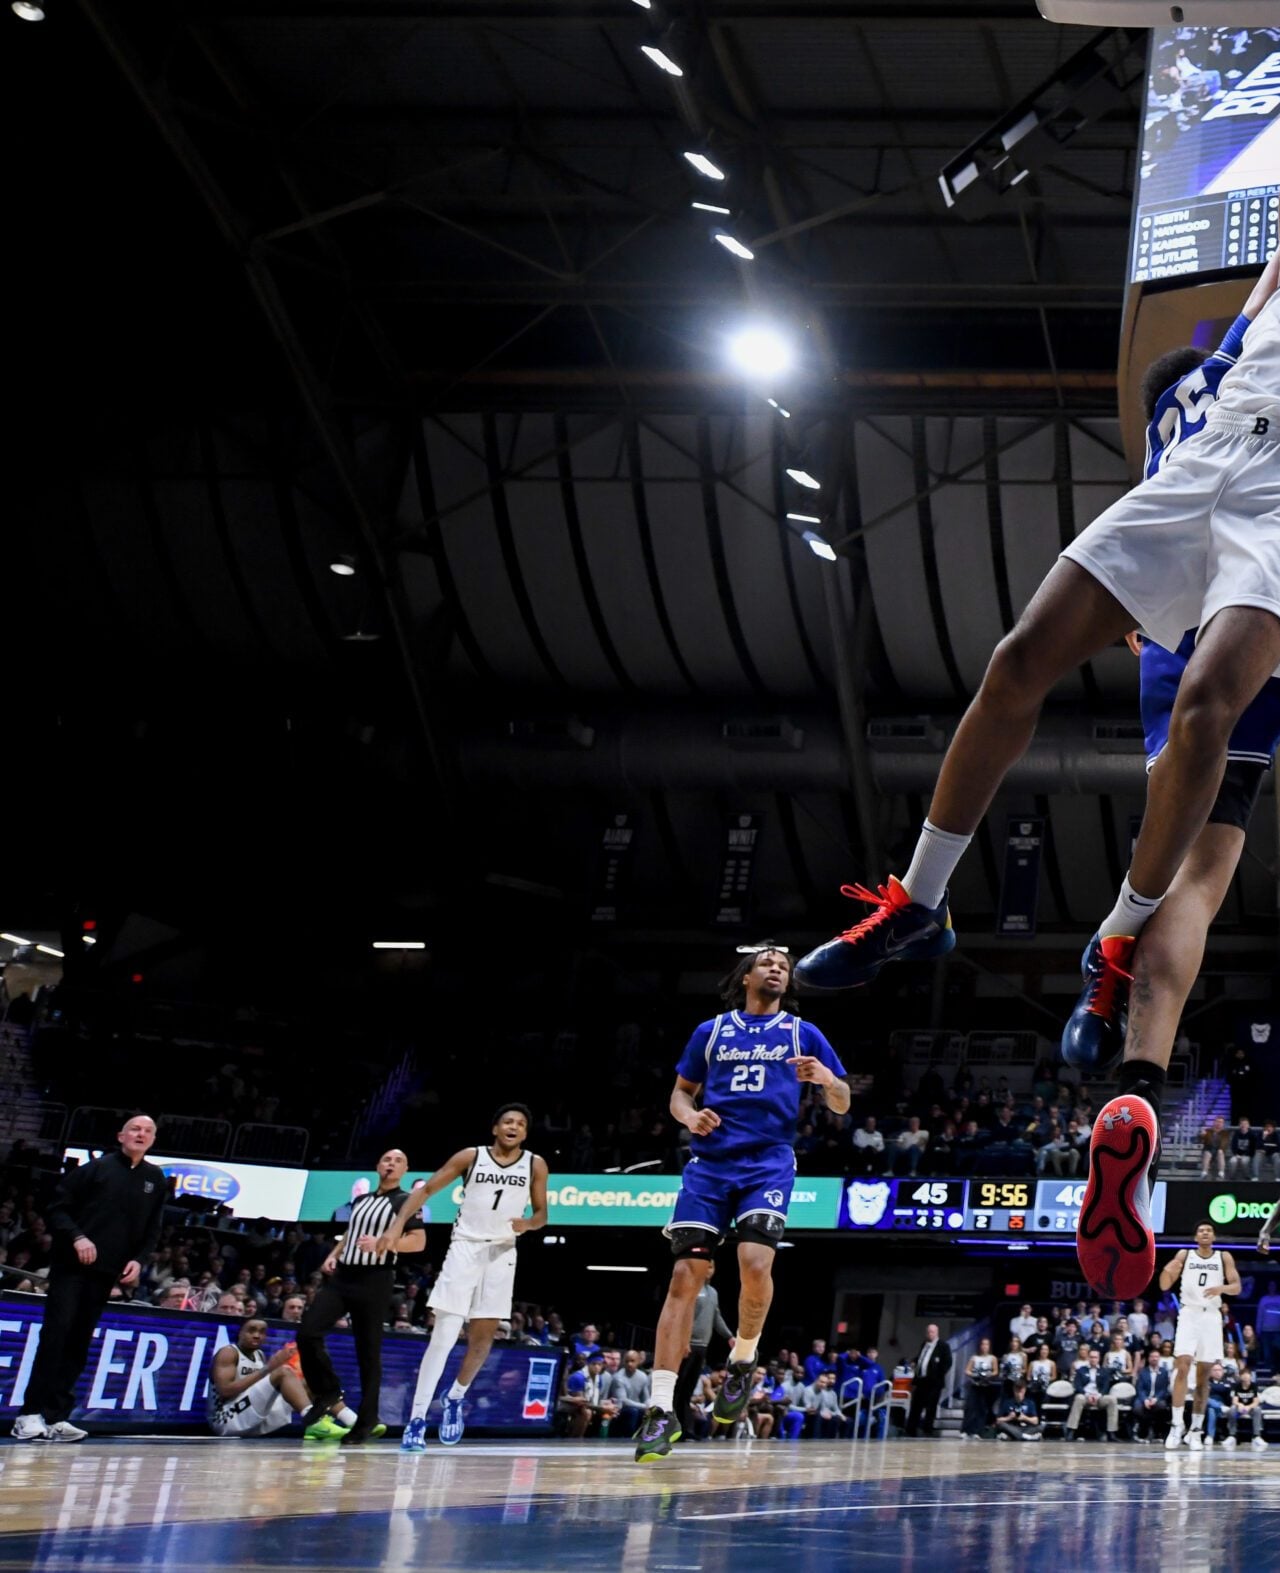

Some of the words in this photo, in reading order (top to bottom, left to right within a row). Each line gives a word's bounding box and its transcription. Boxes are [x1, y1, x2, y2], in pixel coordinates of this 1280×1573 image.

[1231, 202, 1241, 213] 5
[1250, 199, 1261, 210] 4
[1268, 197, 1279, 208] 0
[1142, 230, 1149, 241] 1
[1230, 215, 1240, 227] 5
[1249, 213, 1260, 223] 0
[1268, 210, 1279, 221] 0
[1139, 243, 1149, 254] 7
[1249, 226, 1259, 237] 2
[1269, 224, 1276, 234] 1
[1248, 240, 1258, 251] 2
[1228, 256, 1238, 266] 4
[1251, 417, 1269, 435] B
[716, 1044, 751, 1061] Seton
[751, 1044, 789, 1061] Hall
[730, 1064, 765, 1092] 23
[173, 1173, 233, 1194] IELE
[475, 1172, 527, 1187] DAWGS
[452, 1186, 677, 1207] CnGreen.co
[491, 1189, 504, 1210] 1
[911, 1183, 948, 1205] 45
[981, 1184, 1028, 1206] 9:56
[1056, 1185, 1087, 1207] 40
[916, 1216, 927, 1227] 4
[932, 1216, 942, 1227] 3
[975, 1215, 987, 1228] 2
[1056, 1216, 1066, 1228] 2
[1198, 1273, 1207, 1286] 0
[1050, 1281, 1095, 1298] BUT
